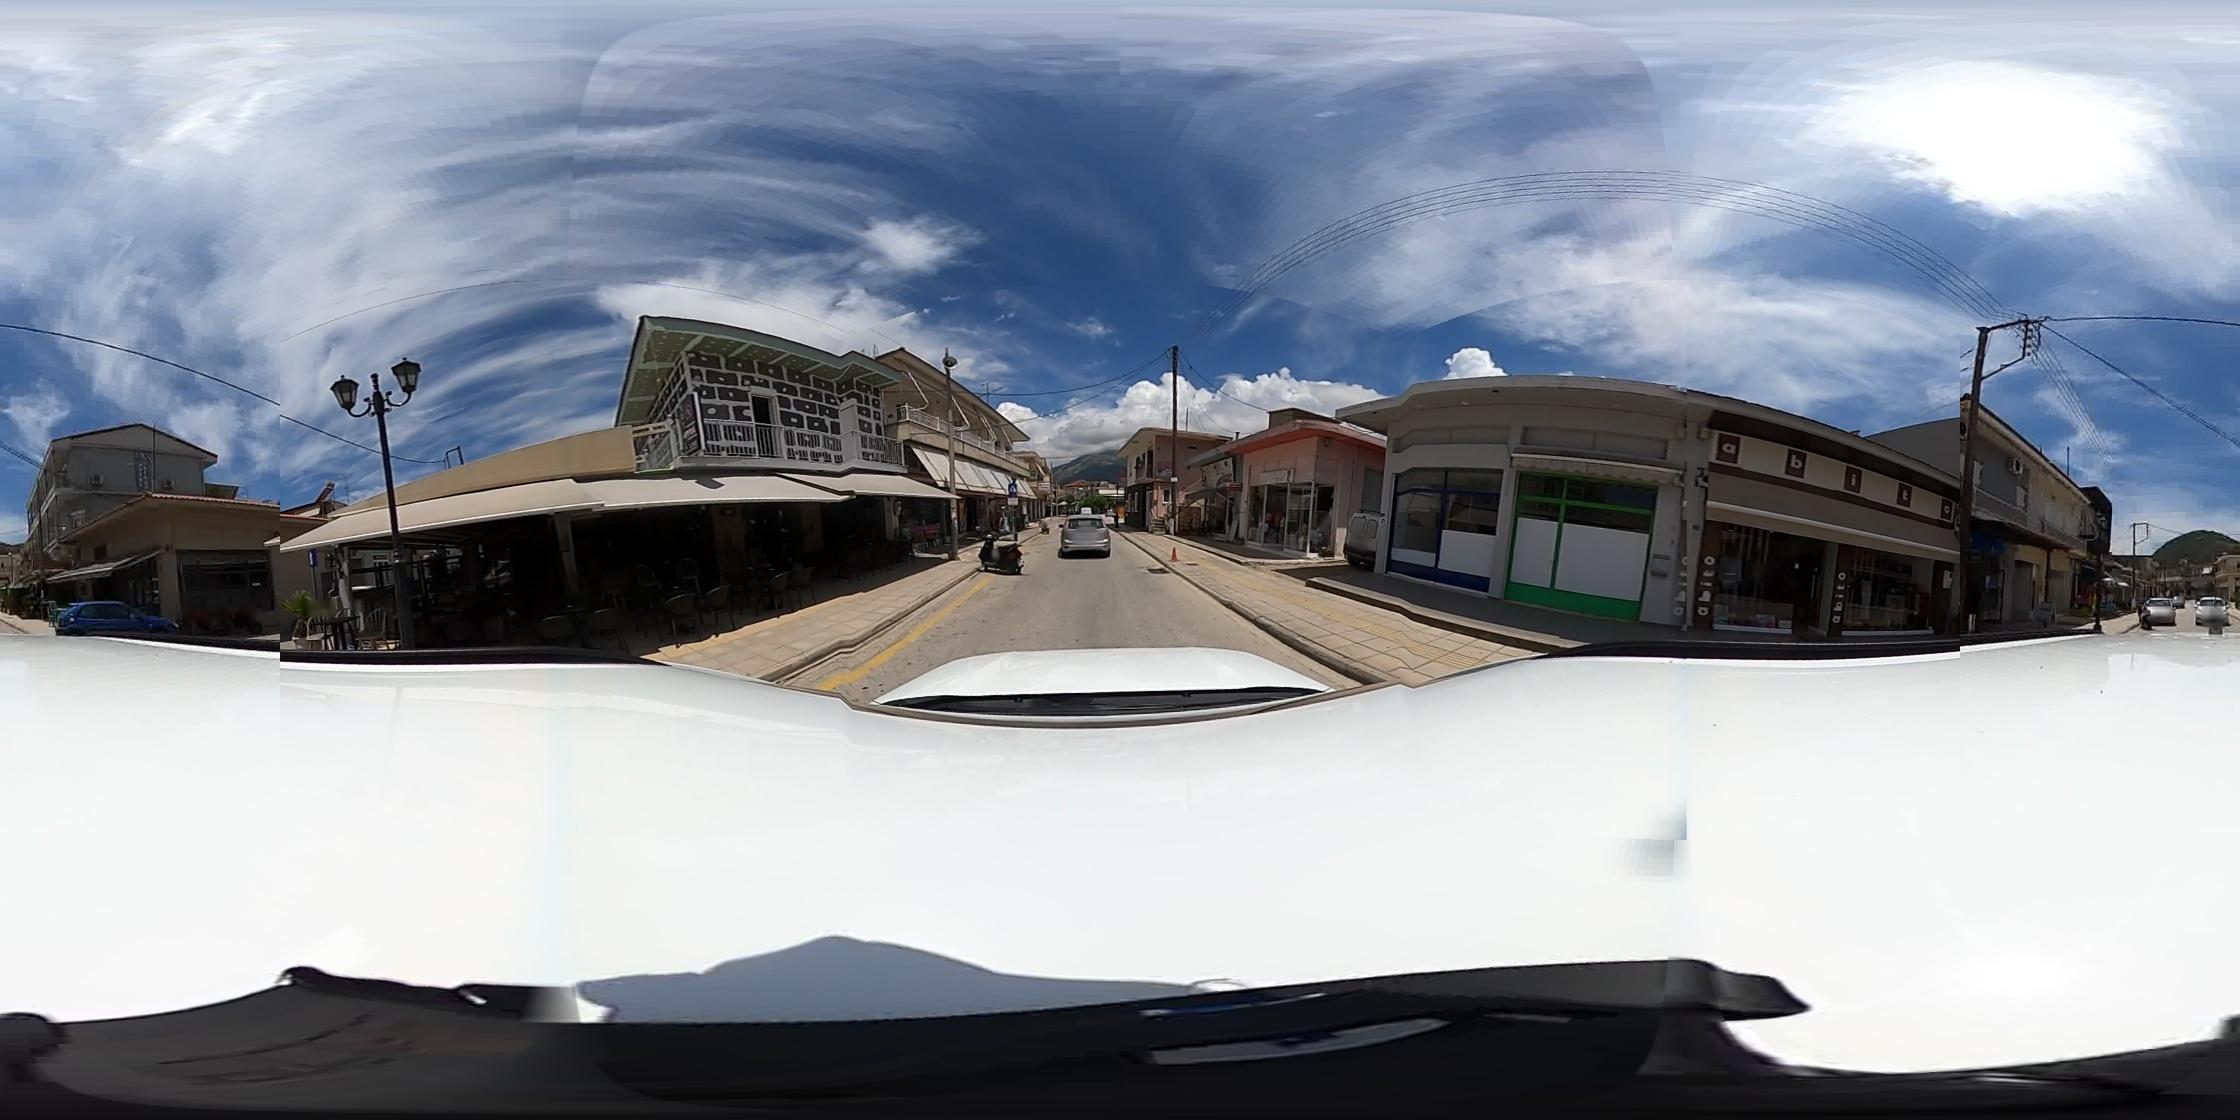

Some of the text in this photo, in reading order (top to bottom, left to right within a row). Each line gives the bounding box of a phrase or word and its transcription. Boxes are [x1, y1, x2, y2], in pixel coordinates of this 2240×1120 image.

[1722, 443, 1951, 514] abito
[1697, 556, 1715, 616] abito
[1832, 572, 1847, 624] abito
